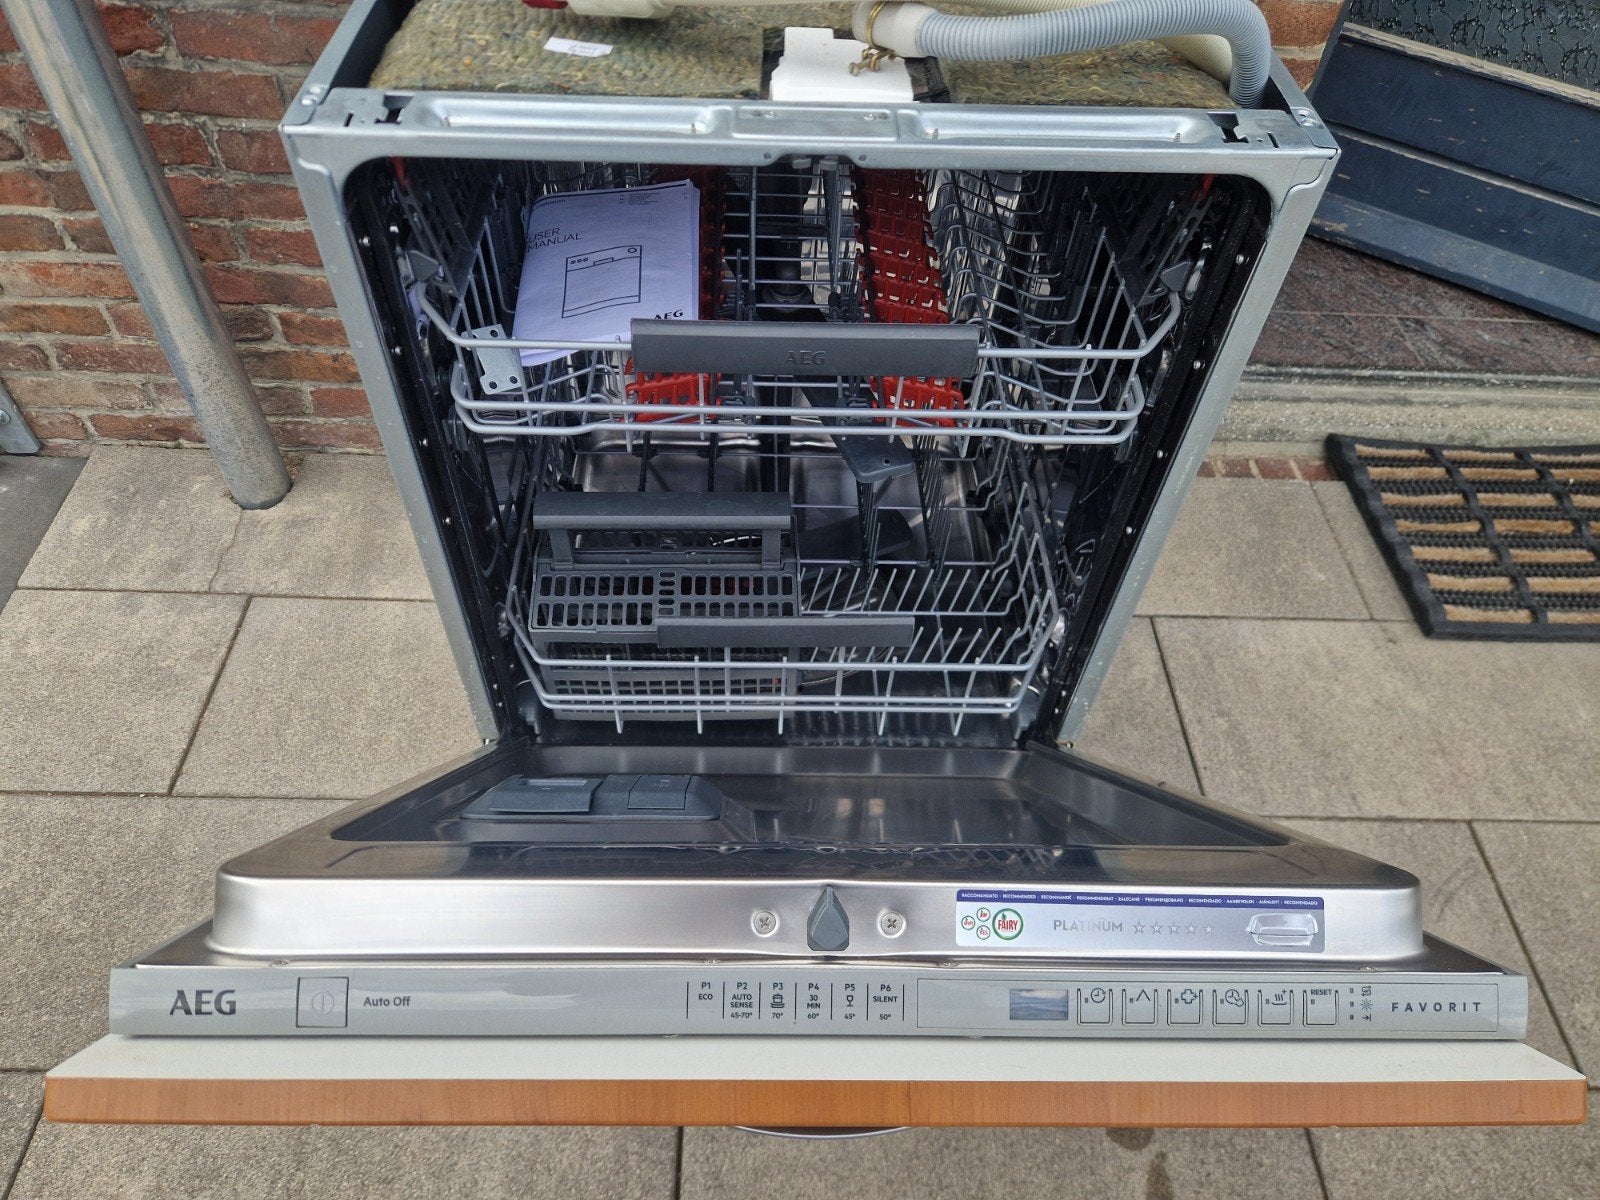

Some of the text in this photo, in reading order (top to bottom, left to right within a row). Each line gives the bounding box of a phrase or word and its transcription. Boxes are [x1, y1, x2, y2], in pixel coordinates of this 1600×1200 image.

[528, 227, 560, 243] USER
[527, 231, 583, 254] MANUAL
[784, 349, 827, 366] AEG
[997, 919, 1019, 931] FAIRY
[1053, 918, 1123, 932] PLATINUM
[700, 981, 712, 990] P1
[736, 981, 748, 990] P2
[772, 982, 784, 991] P3
[808, 982, 820, 991] P4
[844, 983, 856, 992] P5
[880, 984, 892, 992] P6
[1310, 988, 1333, 996] RESET
[363, 996, 411, 1007] Auto Off
[698, 993, 713, 1001] ECO
[731, 993, 753, 1001] AUTO
[809, 994, 819, 1002] 30
[872, 995, 898, 1003] SILENT
[169, 988, 237, 1016] AEG
[730, 1001, 754, 1009] SENSE
[806, 1001, 821, 1009] MIN
[1391, 1002, 1482, 1012] FAVORIT
